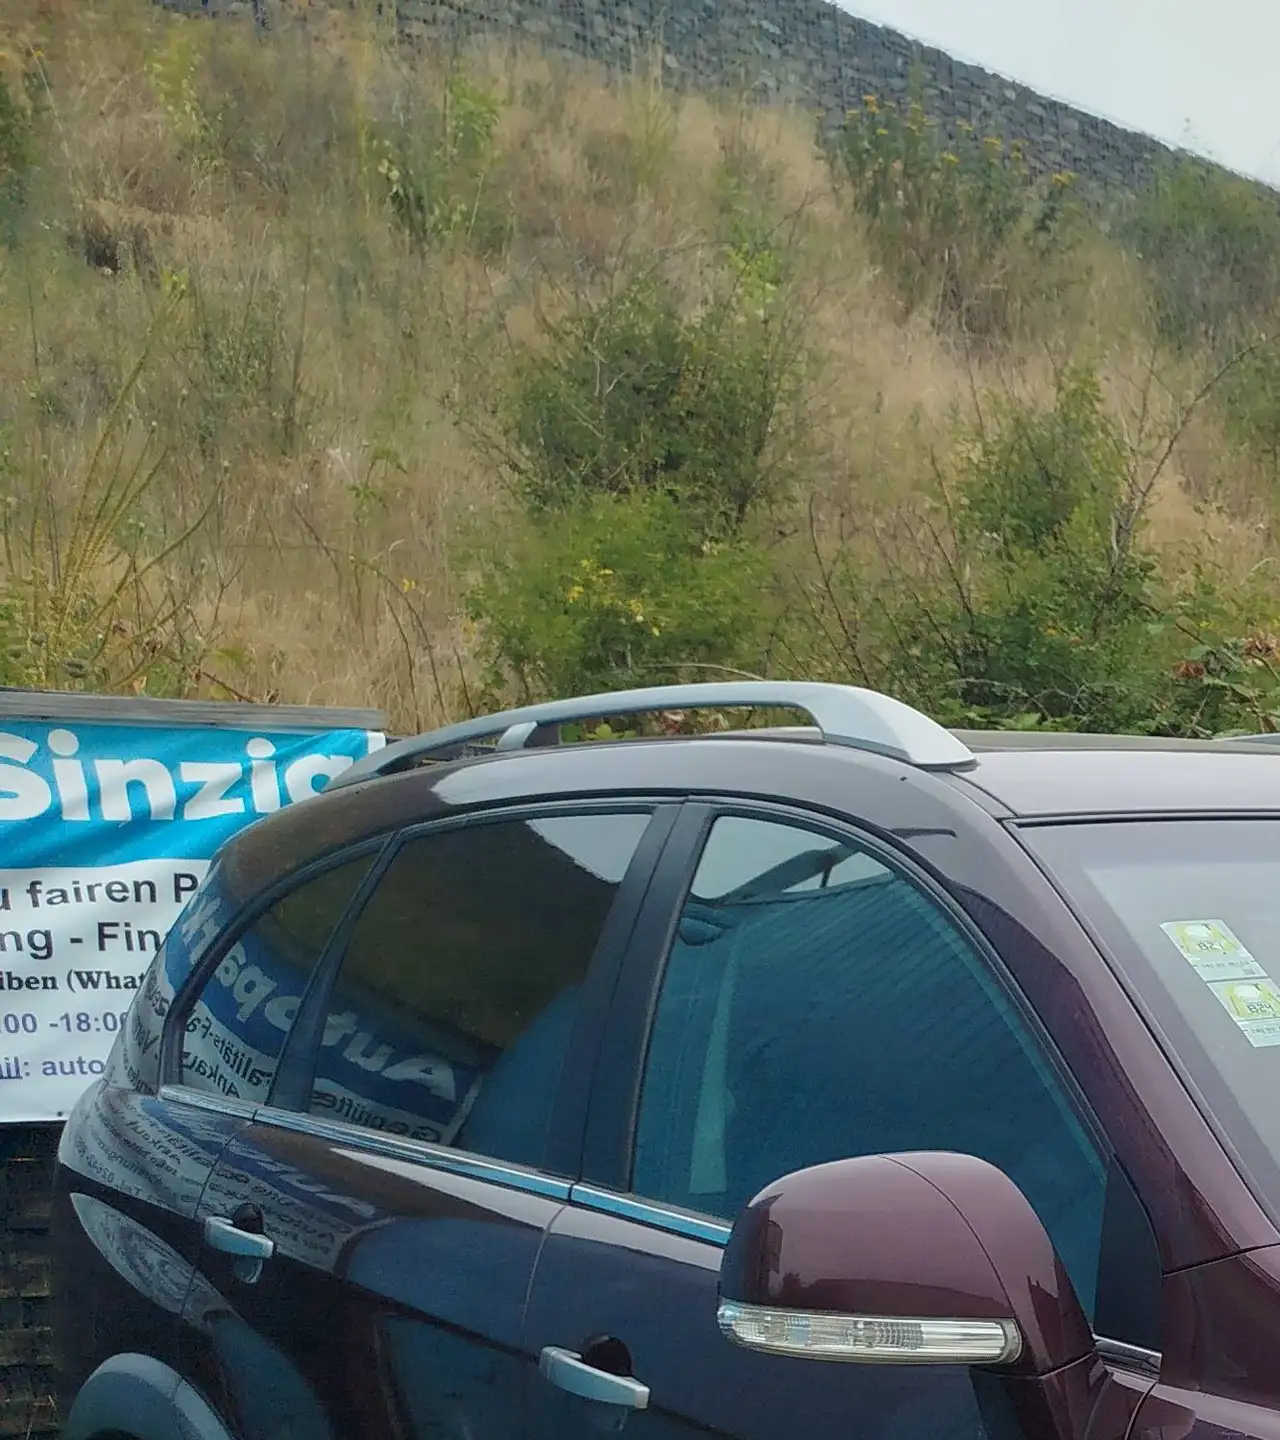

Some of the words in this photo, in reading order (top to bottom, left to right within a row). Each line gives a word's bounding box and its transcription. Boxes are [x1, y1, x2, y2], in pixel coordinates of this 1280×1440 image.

[26, 879, 157, 908] fairen
[97, 921, 164, 952] Fin
[2, 1012, 38, 1034] 00
